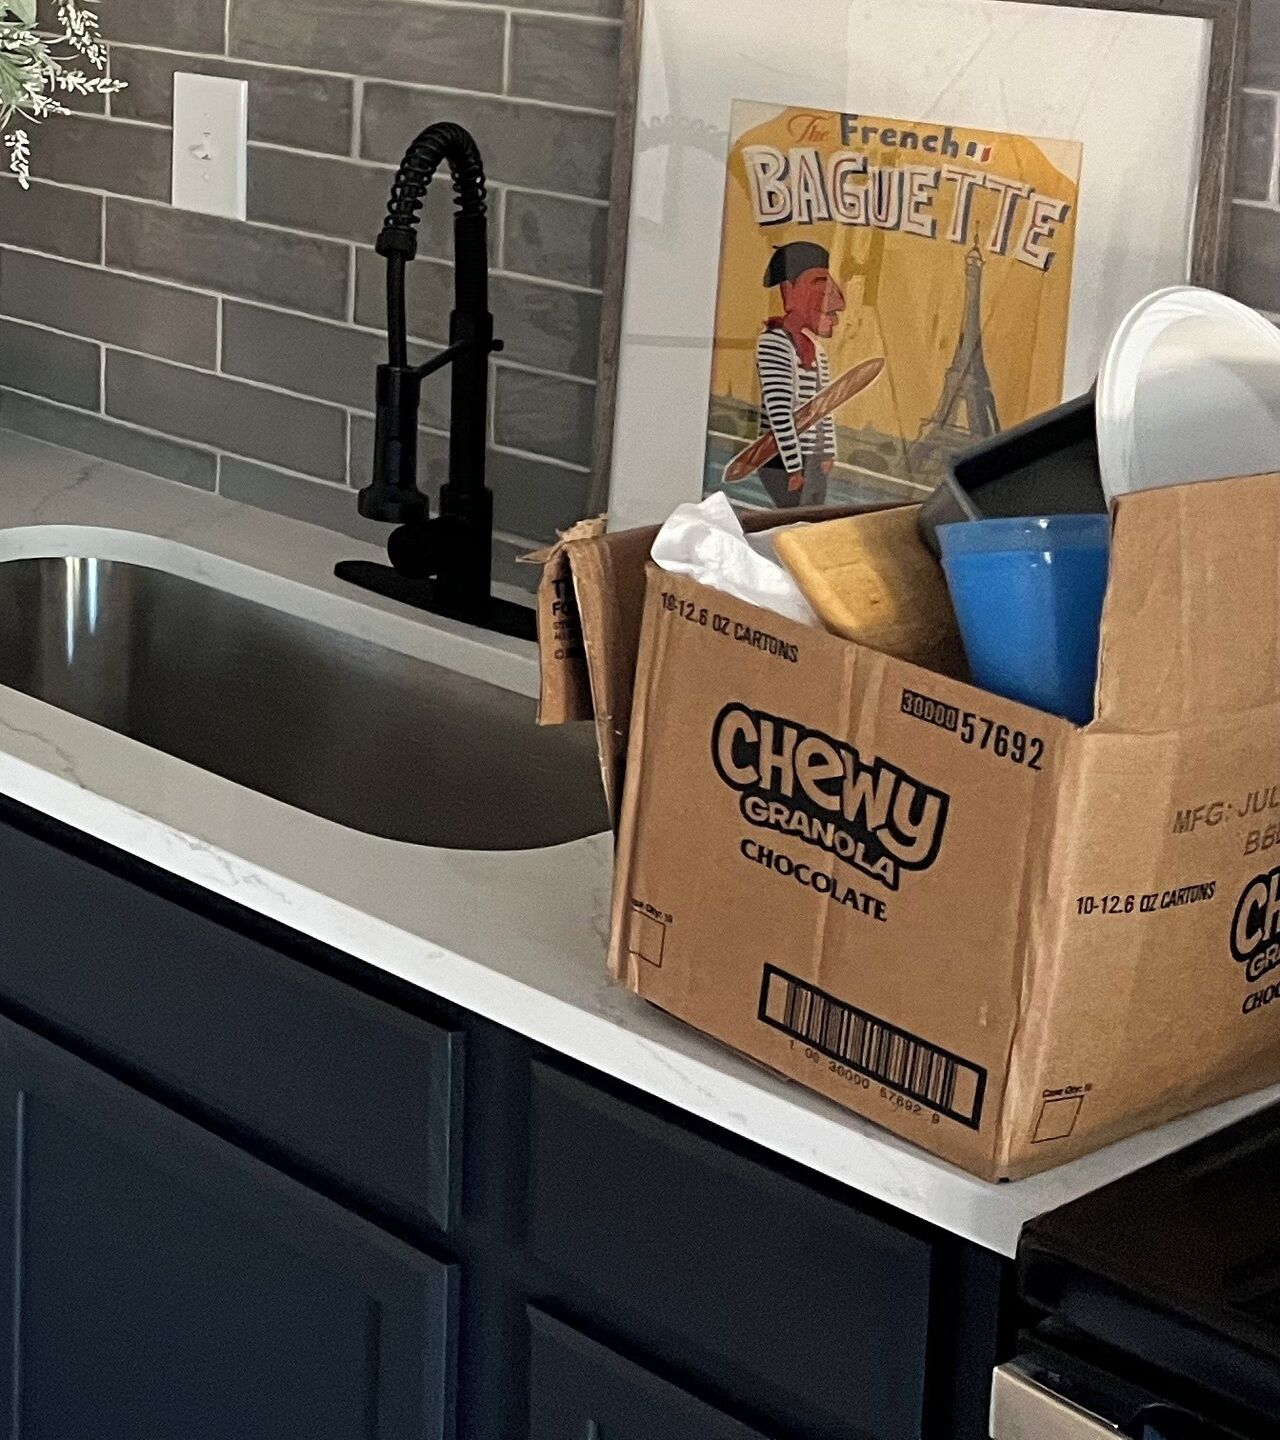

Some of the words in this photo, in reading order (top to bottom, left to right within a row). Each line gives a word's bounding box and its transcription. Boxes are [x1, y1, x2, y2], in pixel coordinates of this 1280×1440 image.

[787, 113, 832, 143] The
[840, 112, 960, 159] French
[742, 143, 1073, 272] BAGUETTE
[712, 613, 730, 636] OZ
[734, 623, 799, 663] CARTONS
[902, 690, 958, 731] 30000
[960, 712, 1045, 771] 57692
[740, 838, 888, 922] CHOCOLATE
[744, 795, 894, 886] GRANOLA
[1076, 895, 1135, 914] 10-12.6
[1139, 893, 1159, 913] OZ
[1160, 880, 1216, 910] CARTONS
